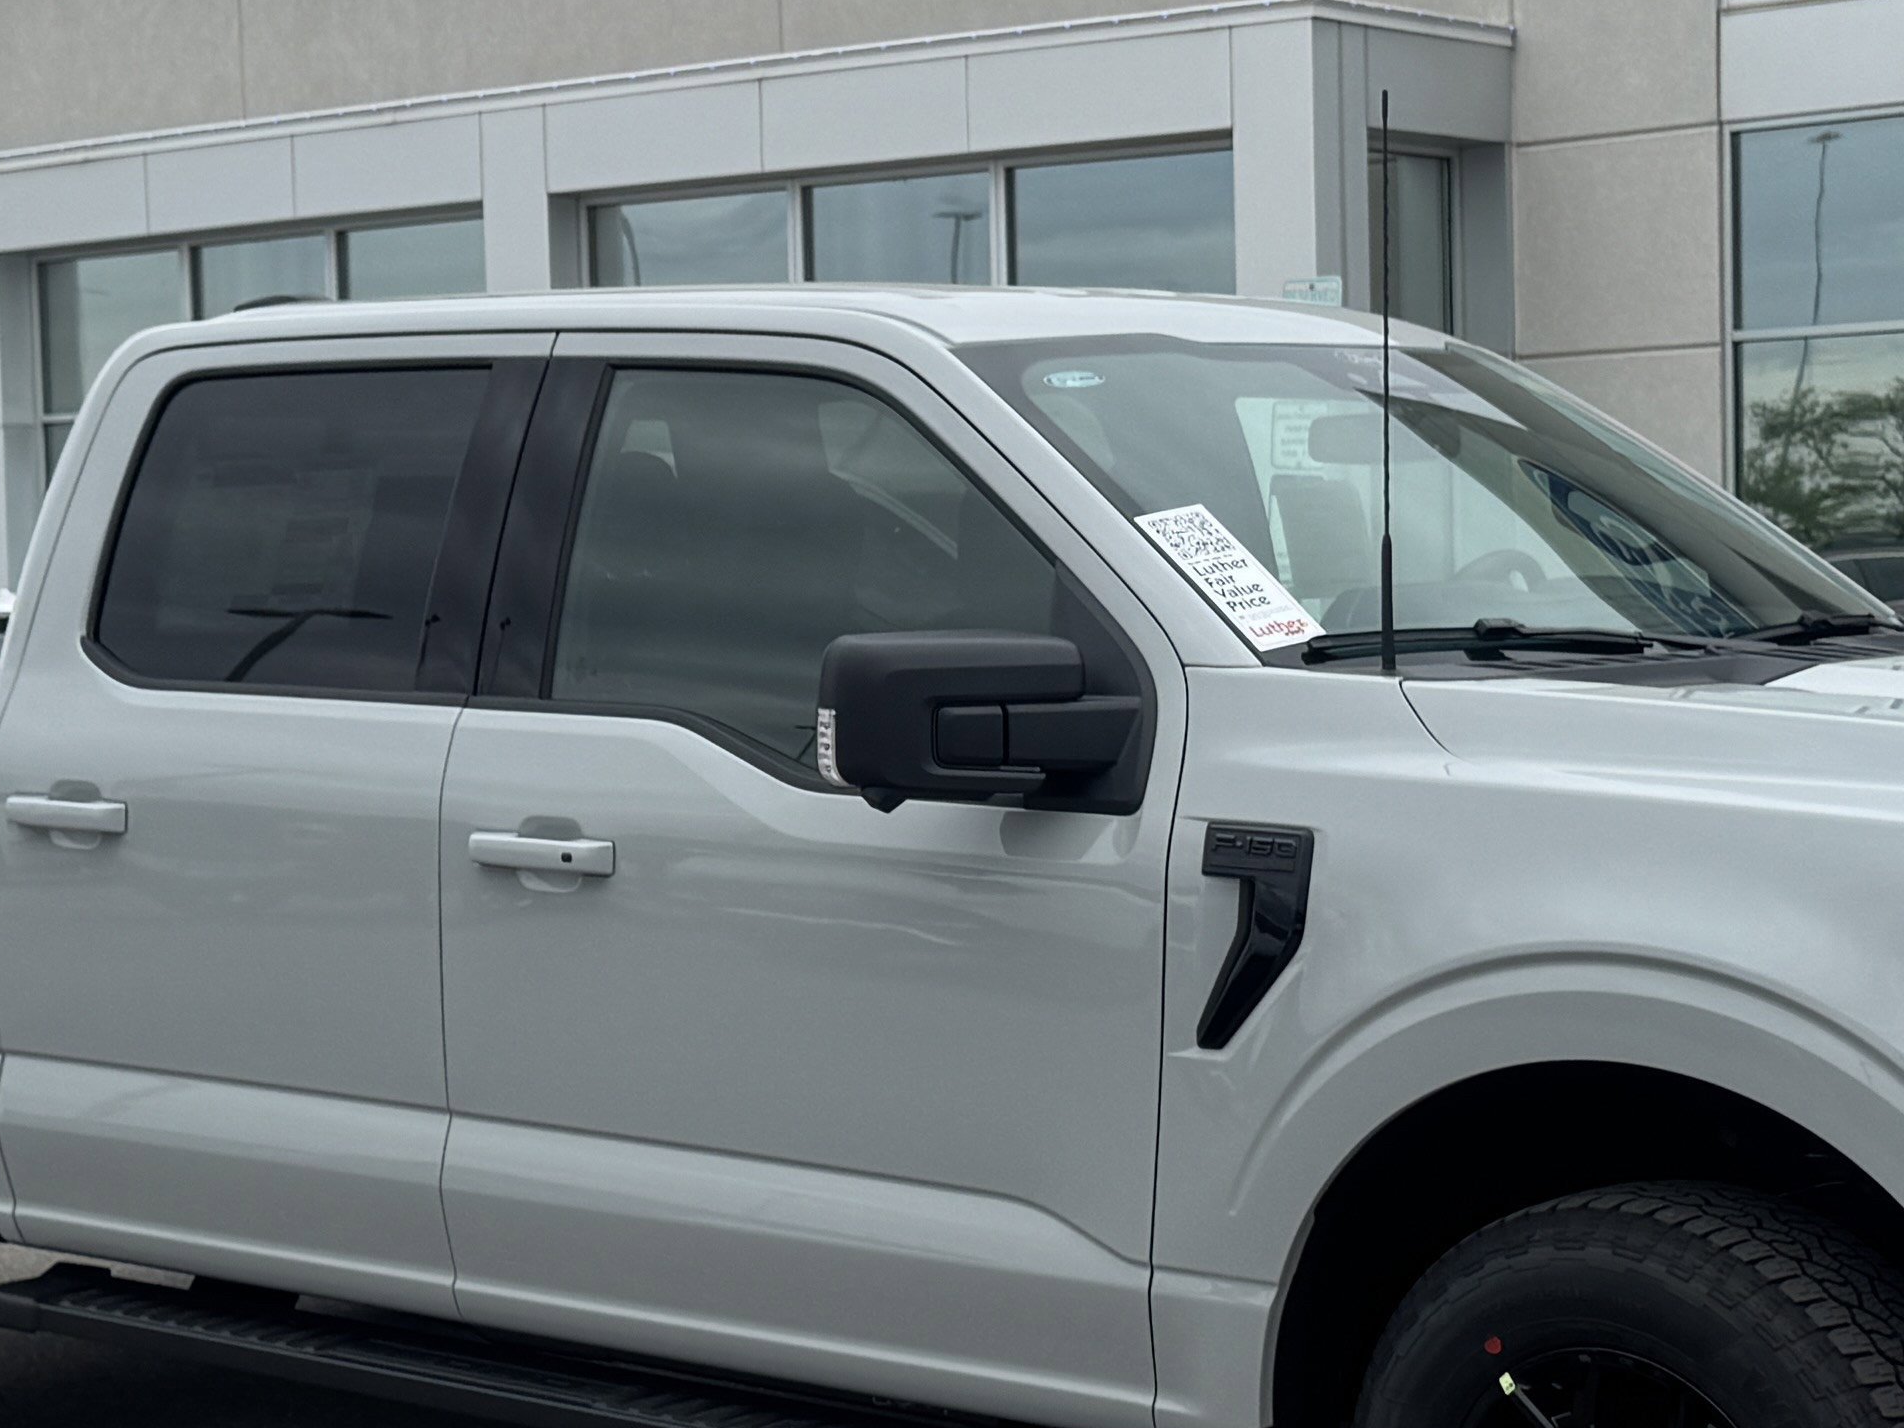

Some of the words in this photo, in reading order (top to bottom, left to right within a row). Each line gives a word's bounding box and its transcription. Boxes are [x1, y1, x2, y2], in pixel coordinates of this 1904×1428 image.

[1192, 557, 1249, 577] Luther
[1204, 574, 1236, 588] Fair
[1214, 583, 1264, 599] Value
[1226, 595, 1271, 613] Price
[1249, 618, 1308, 638] Luther
